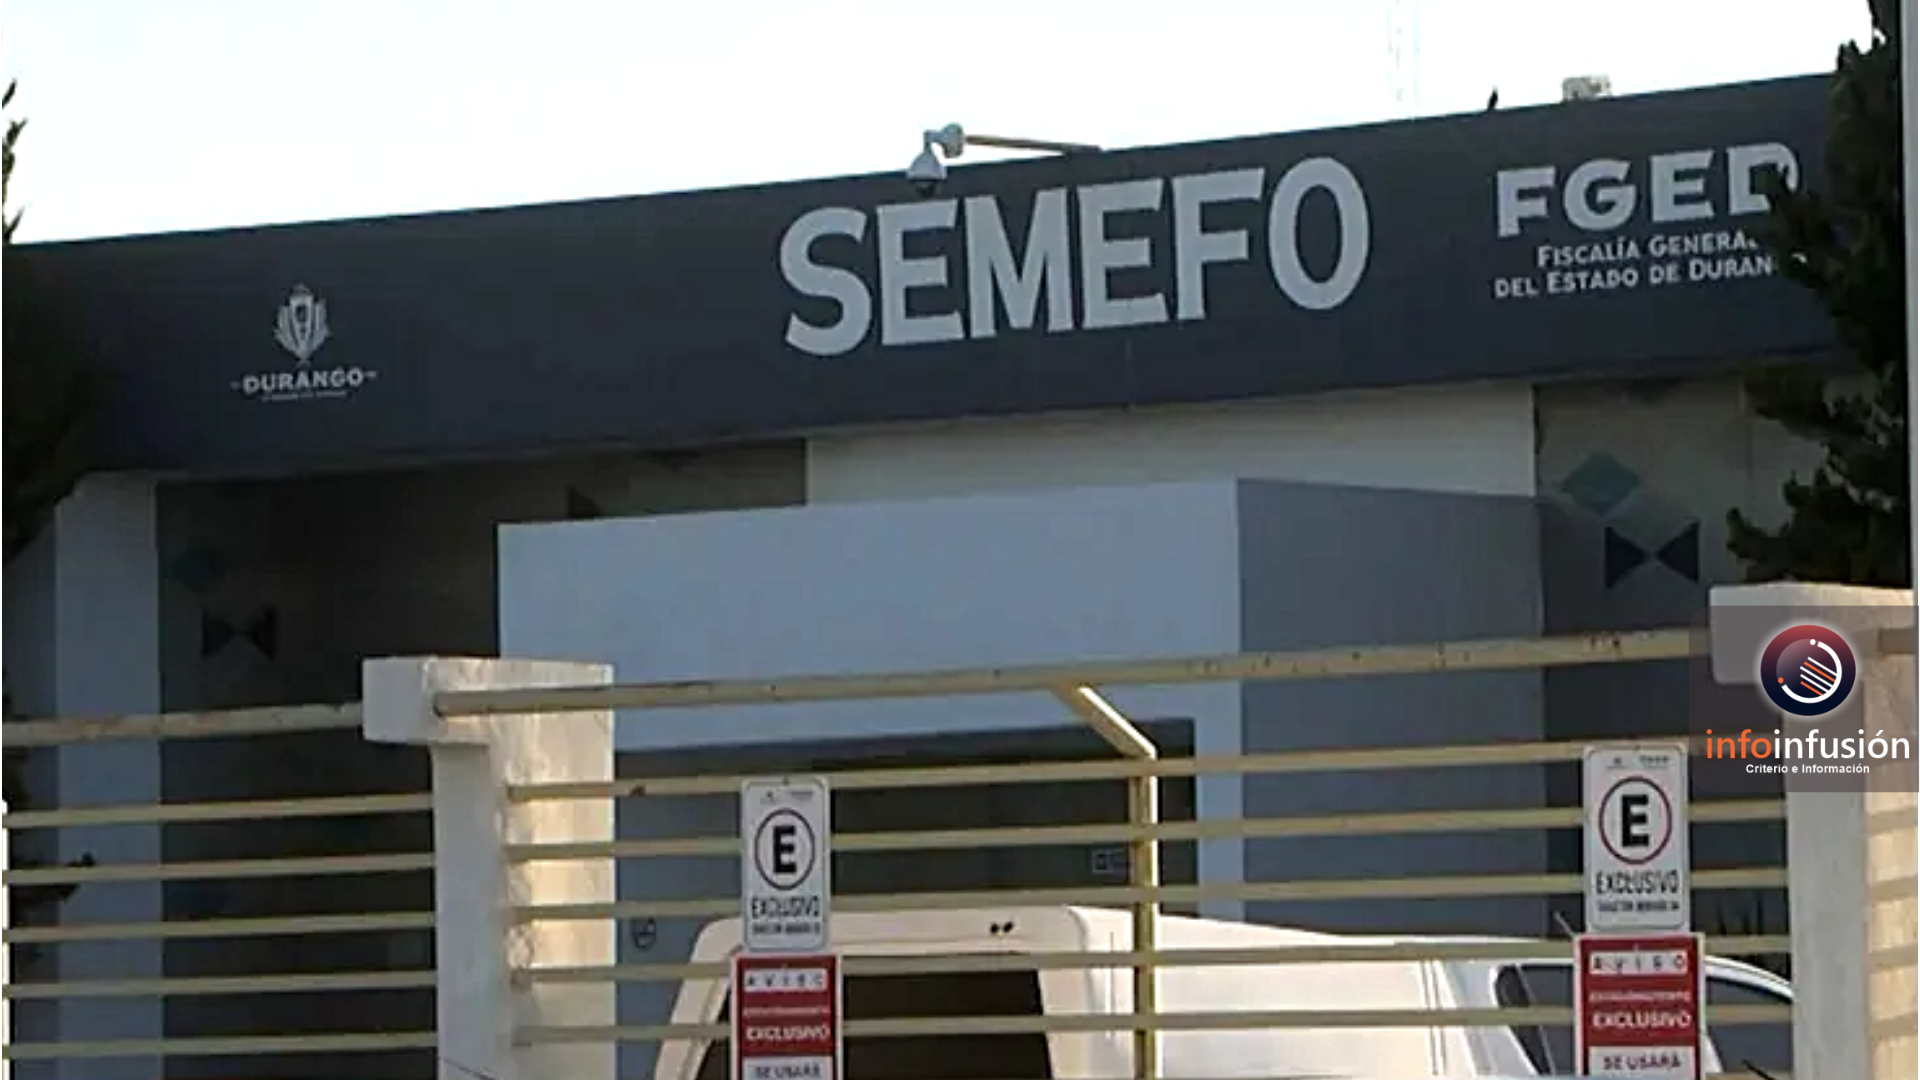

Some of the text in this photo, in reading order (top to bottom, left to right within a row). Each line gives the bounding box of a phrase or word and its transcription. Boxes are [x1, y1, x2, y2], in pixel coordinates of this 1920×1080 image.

[1497, 142, 1800, 238] FGED
[779, 156, 1370, 357] SEMEFO
[1537, 229, 1759, 268] FISCALÍA GENERA
[1494, 277, 1539, 298] DEL
[1547, 267, 1639, 293] ESTADO
[1649, 262, 1681, 284] DE
[241, 365, 364, 395] DURANGO
[1621, 794, 1650, 848] E
[772, 824, 797, 874] E
[1595, 868, 1680, 895] EXCLUSIVO
[751, 895, 820, 919] EXCLUSIVO
[745, 1024, 832, 1041] EXCLUSIVO
[1592, 1010, 1692, 1028] EXCLUSIVO
